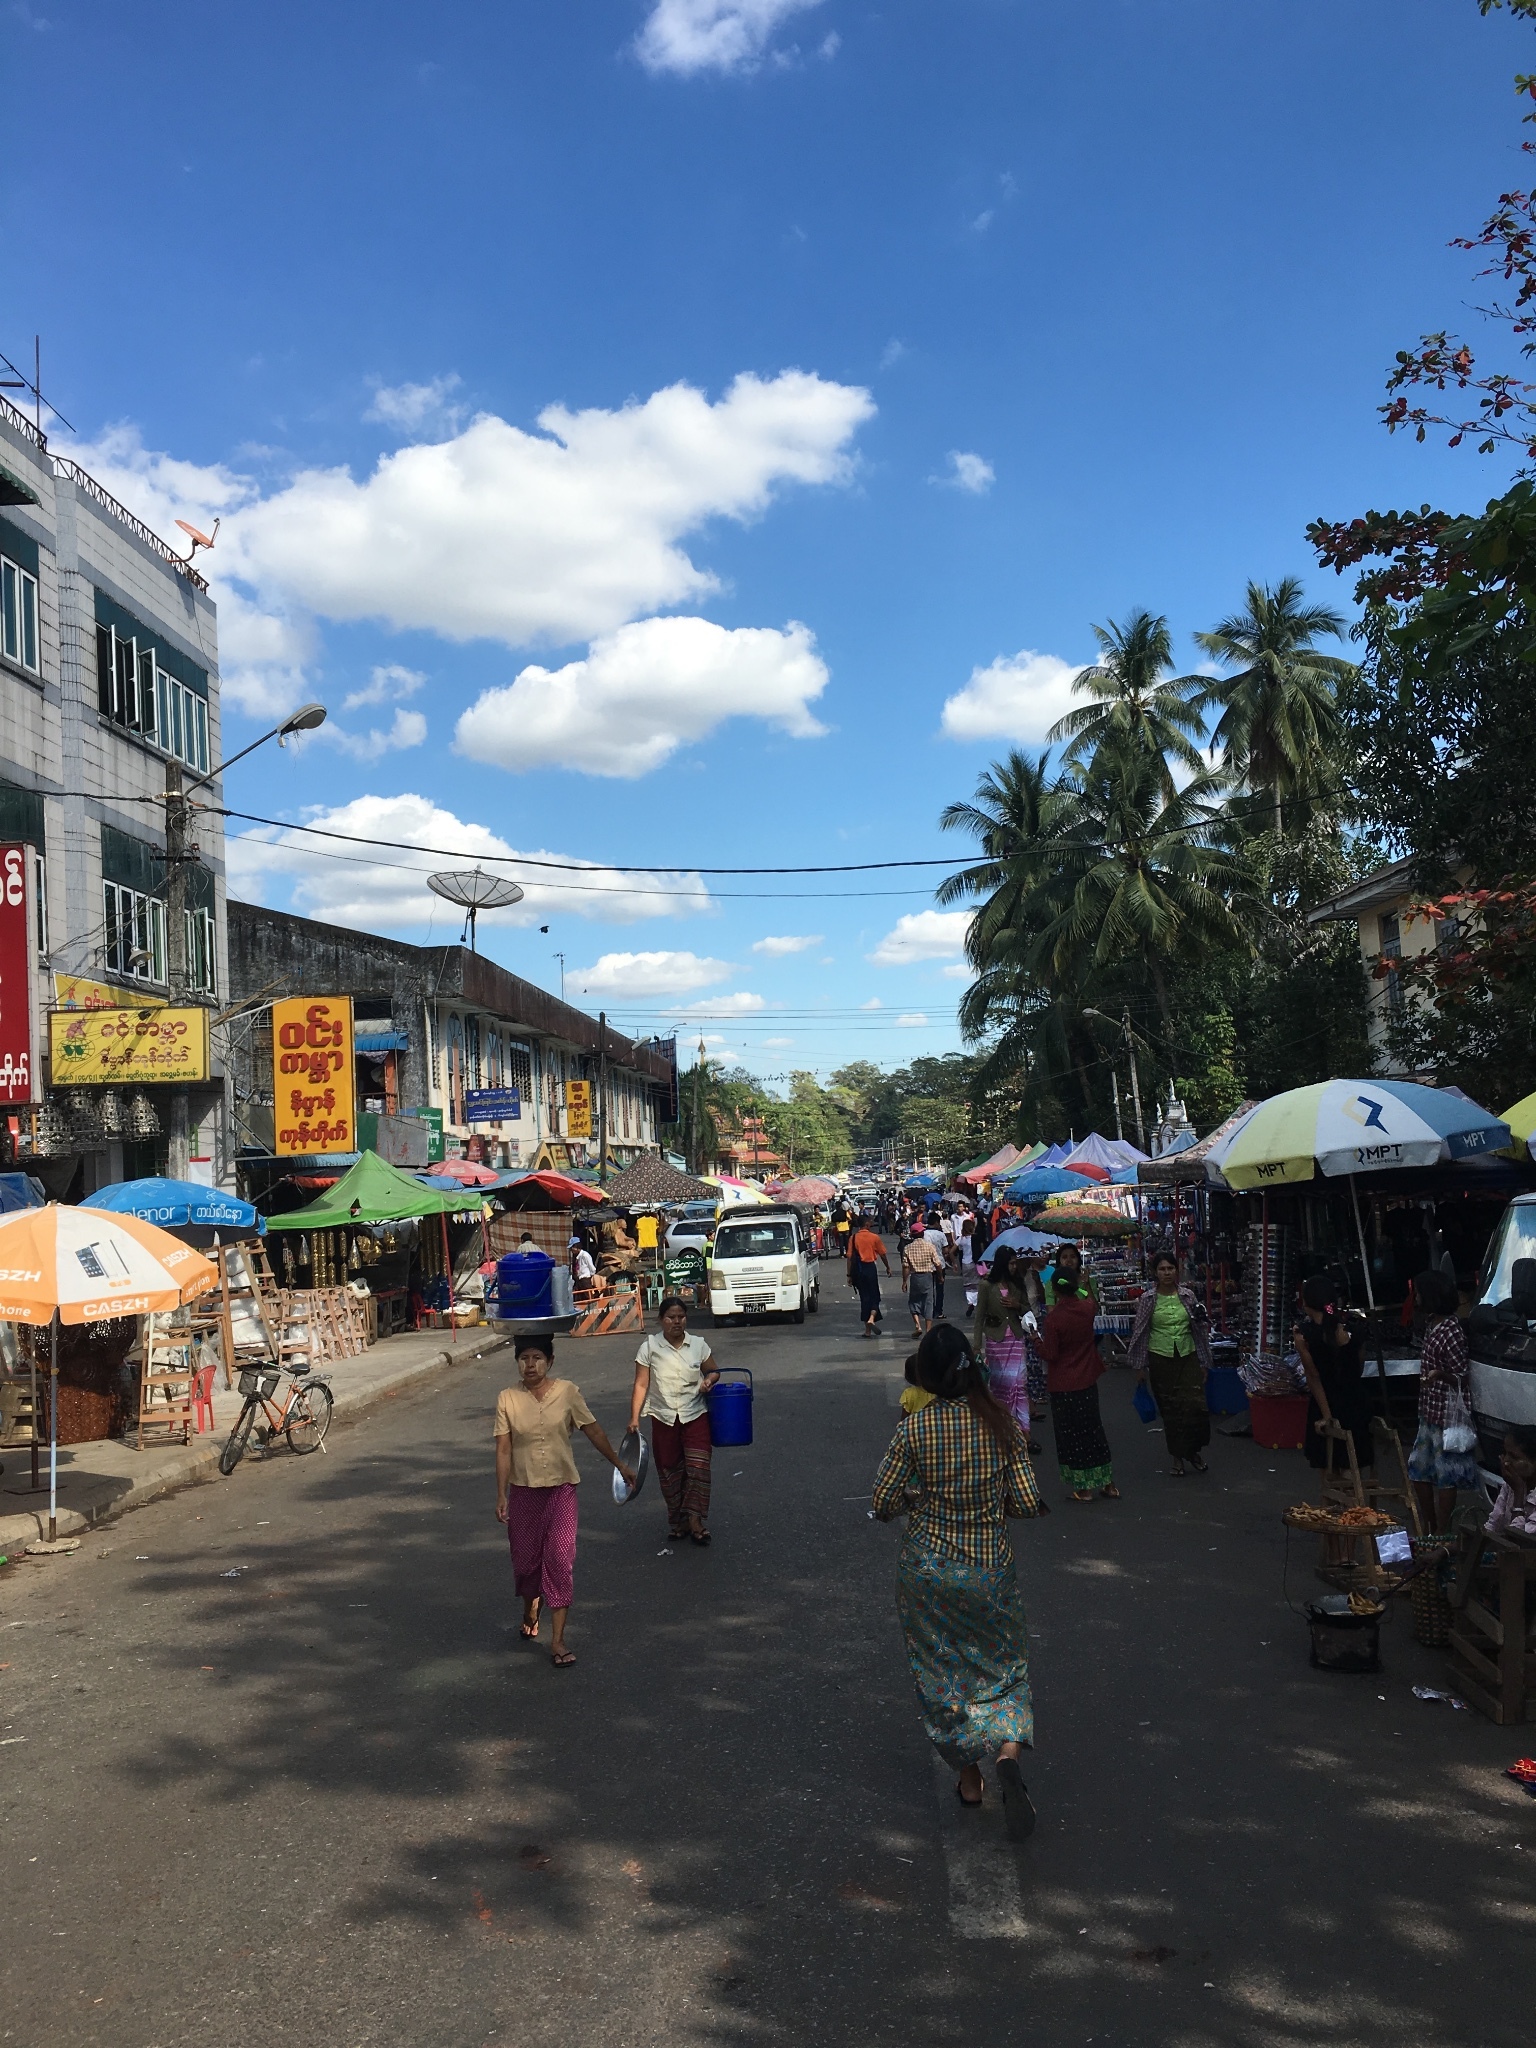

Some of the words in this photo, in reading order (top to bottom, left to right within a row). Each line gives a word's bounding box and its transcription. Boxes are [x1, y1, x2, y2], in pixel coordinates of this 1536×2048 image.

[279, 1005, 343, 1049] ဝင်း
[1463, 1131, 1486, 1149] MPT
[1366, 1144, 1403, 1160] MPT
[1257, 1162, 1286, 1179] MPT
[161, 1248, 193, 1268] CASZH
[83, 1297, 149, 1317] CASZH
